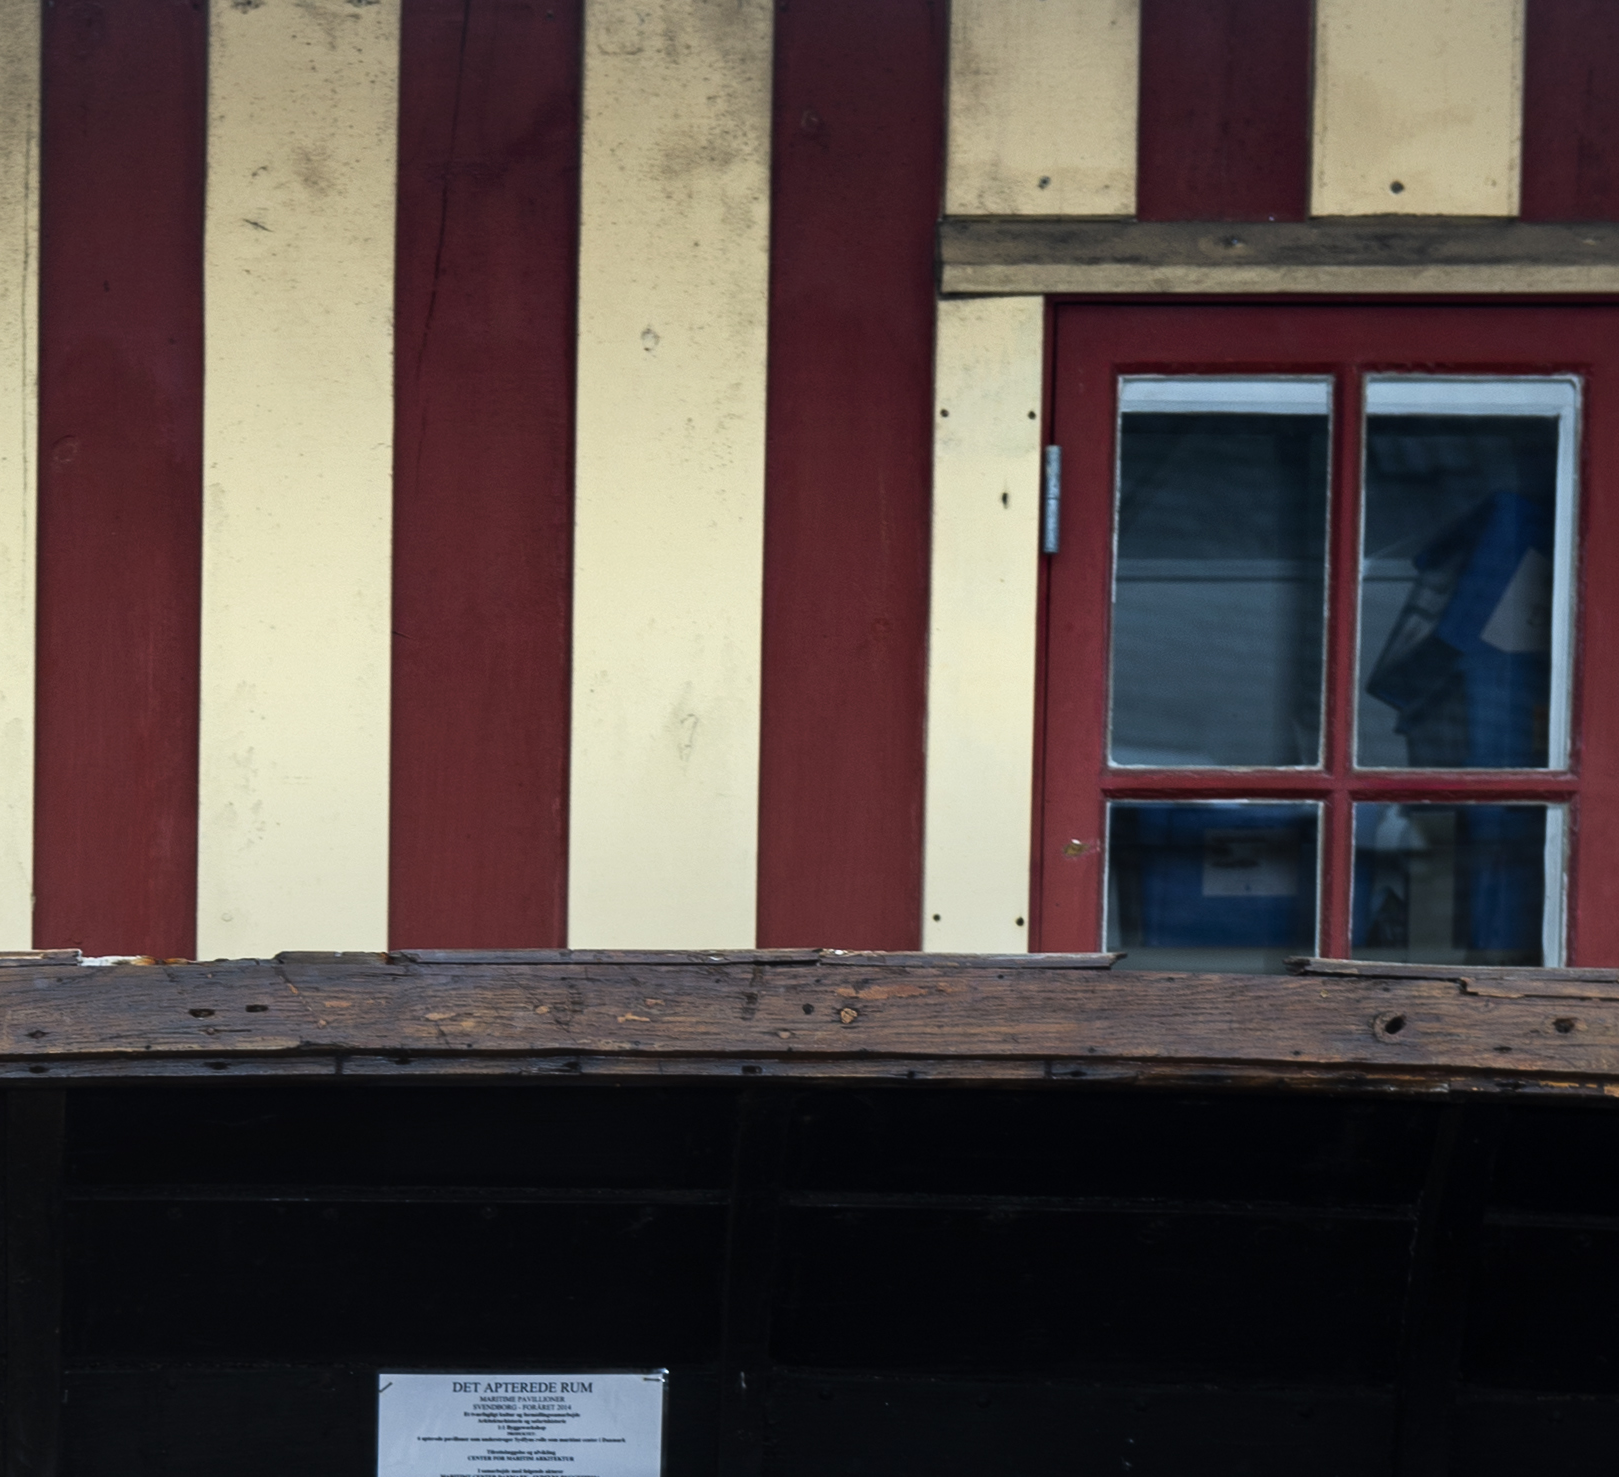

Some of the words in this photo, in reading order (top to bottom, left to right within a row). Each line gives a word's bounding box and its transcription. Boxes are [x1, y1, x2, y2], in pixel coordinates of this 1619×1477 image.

[453, 1382, 481, 1393] DET
[484, 1382, 556, 1393] APTEREDE
[560, 1382, 593, 1393] RUM
[522, 1403, 555, 1411] FORÅRET
